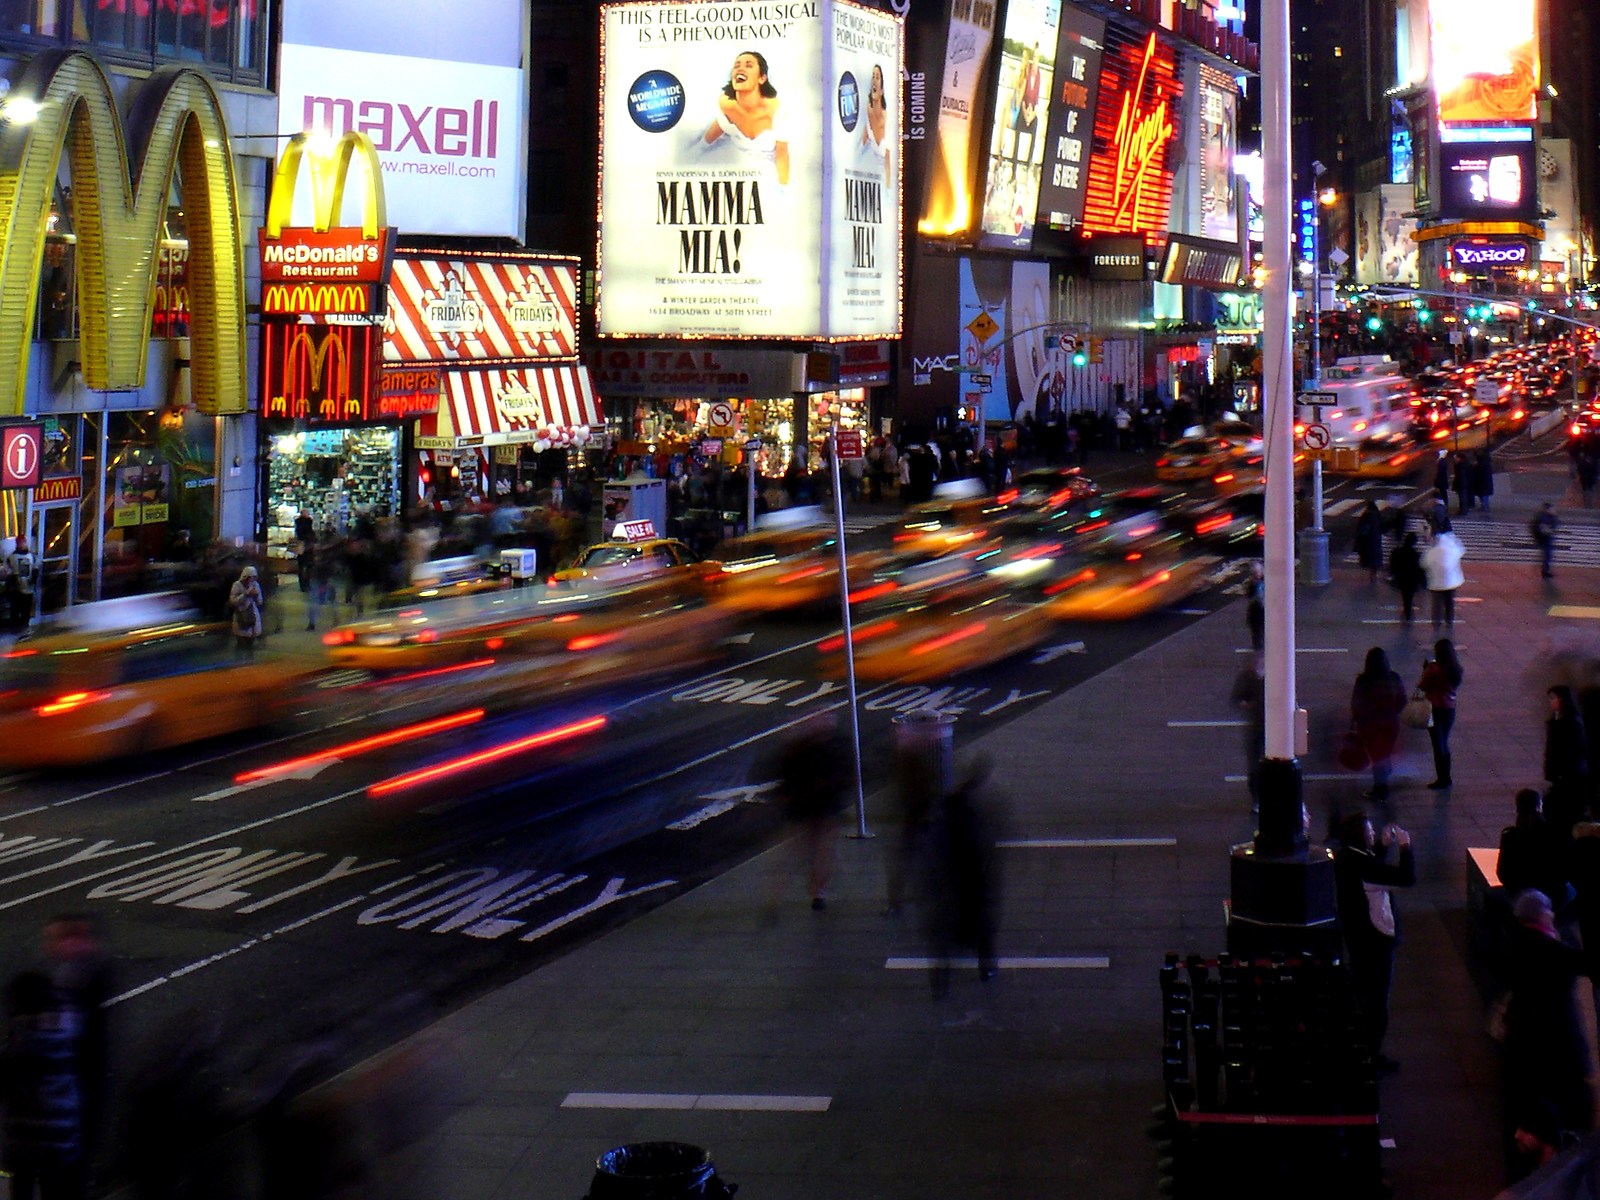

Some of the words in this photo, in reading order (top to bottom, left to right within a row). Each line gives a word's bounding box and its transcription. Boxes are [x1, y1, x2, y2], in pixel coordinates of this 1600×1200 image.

[659, 6, 744, 24] FEEL-GOOD
[750, 2, 820, 21] MUSICAL
[639, 28, 652, 43] IS
[659, 26, 668, 42] A
[911, 72, 925, 120] COMING
[941, 96, 969, 114] DURACELL
[303, 95, 498, 160] maxell
[911, 125, 925, 140] IS
[656, 180, 764, 225] MAMMA
[844, 178, 882, 224] MAMMA
[264, 244, 379, 263] McDonald's
[678, 228, 742, 275] MIA!
[852, 225, 876, 269] MIA!
[1455, 247, 1526, 263] YAHOO!
[1094, 255, 1130, 266] FOREVER
[1131, 255, 1140, 266] 21
[282, 264, 359, 277] Restaurant
[671, 296, 697, 304] WINTER
[699, 296, 727, 304] GARDEN
[729, 296, 759, 304] THEATRE
[431, 303, 475, 321] FRIDAY'S
[514, 306, 553, 321] FRIDAY'S
[669, 307, 710, 316] BROADWAY
[746, 308, 772, 316] STREET
[594, 351, 721, 370] IGITAL
[651, 371, 749, 385] COMPUTERS
[672, 678, 849, 707] ONLY
[86, 846, 400, 914] ONLY
[357, 866, 679, 942] ONLY
